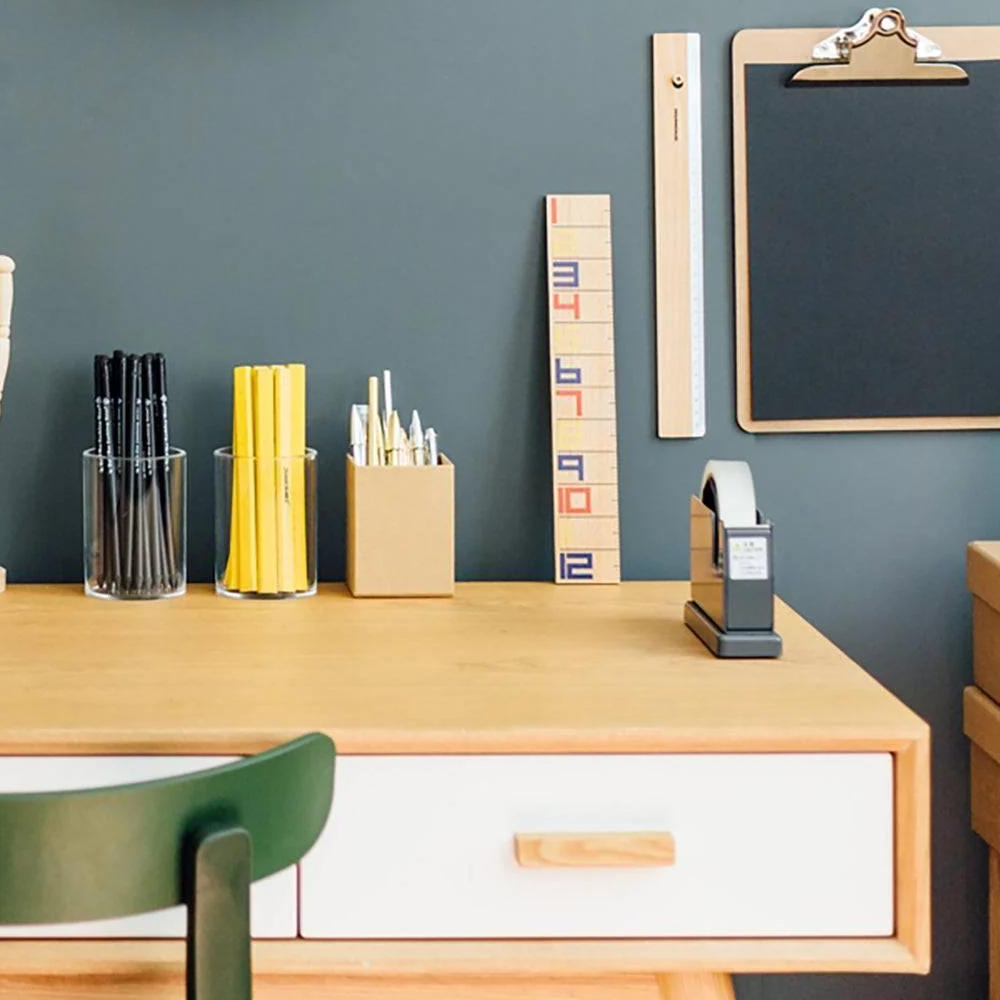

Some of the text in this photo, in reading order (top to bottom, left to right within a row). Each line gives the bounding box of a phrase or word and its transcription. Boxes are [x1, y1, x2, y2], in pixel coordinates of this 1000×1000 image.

[553, 262, 579, 287] 3
[553, 294, 579, 319] 4
[555, 358, 581, 384] 6
[556, 390, 582, 416] 7
[558, 455, 583, 480] 9
[557, 488, 591, 513] 10
[560, 553, 593, 579] 12
